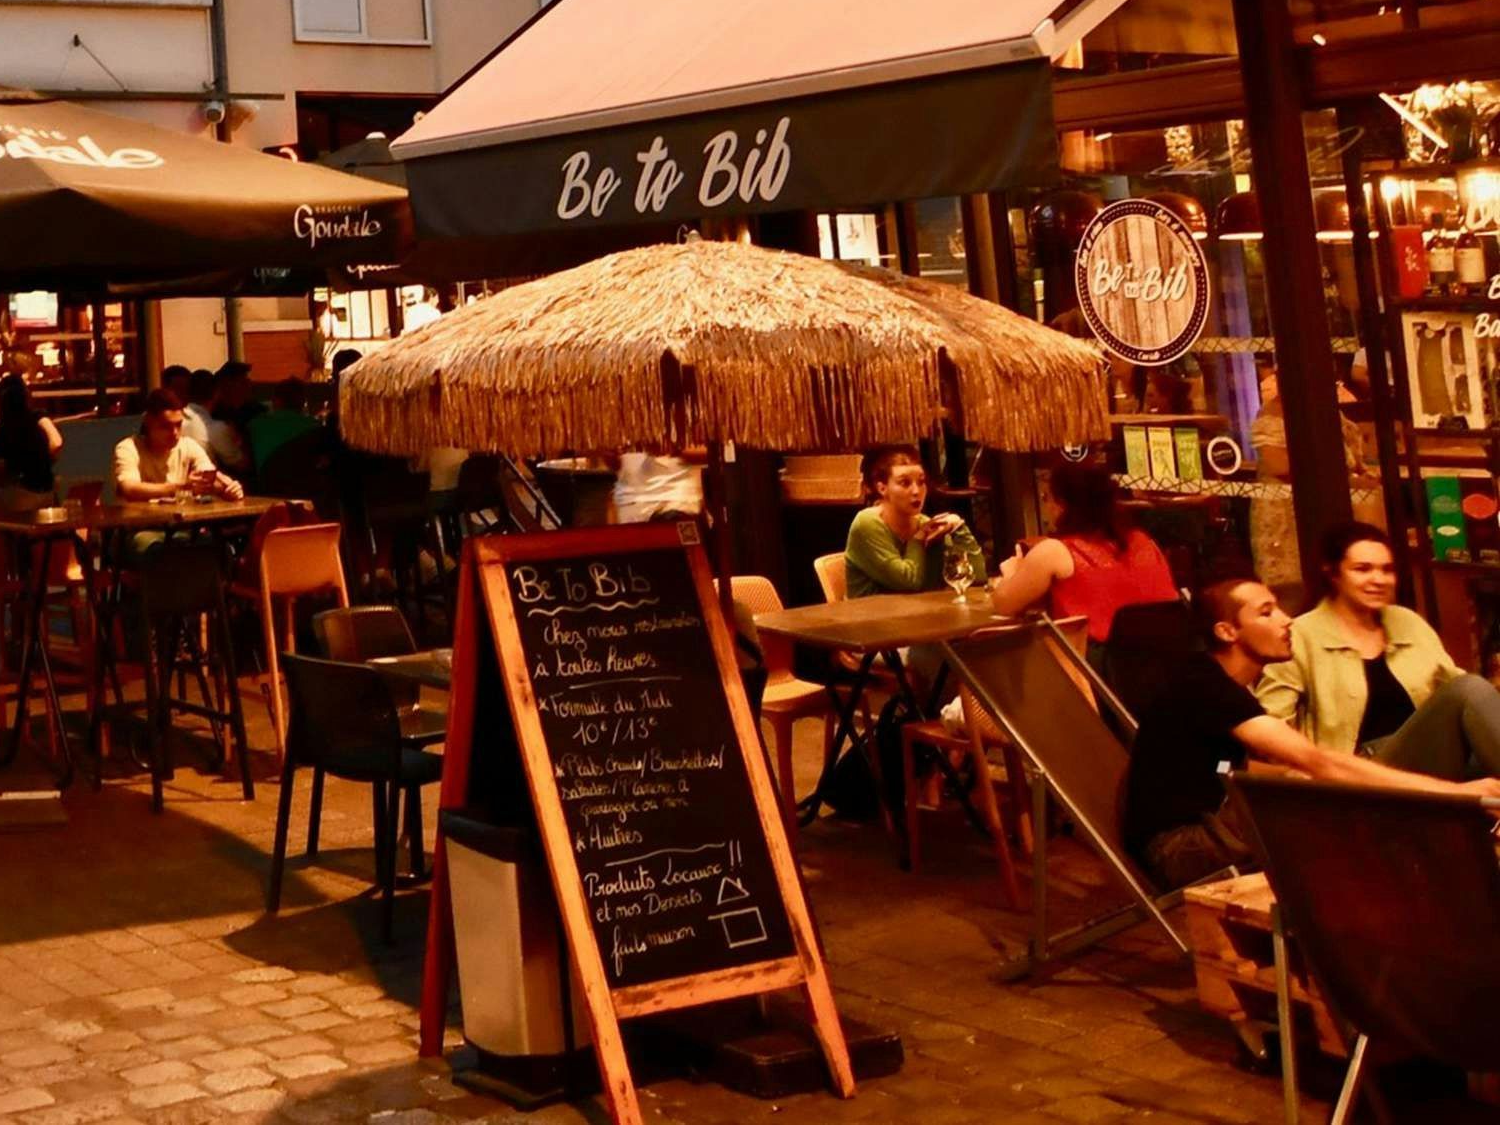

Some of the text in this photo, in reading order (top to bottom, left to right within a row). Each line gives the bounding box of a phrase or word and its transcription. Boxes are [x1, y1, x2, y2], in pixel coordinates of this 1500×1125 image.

[557, 116, 791, 220] Be to Bib
[294, 204, 381, 249] Goudale
[1092, 259, 1124, 296] Be
[1141, 257, 1189, 302] Bib
[513, 562, 651, 603] Be To Bib
[544, 619, 588, 652] Chez
[587, 626, 628, 639] nous
[533, 646, 657, 679] à toutes heures
[614, 694, 636, 715] du
[584, 865, 656, 899] Produits
[596, 899, 612, 923] et
[615, 904, 641, 919] nos
[611, 925, 648, 977] faits
